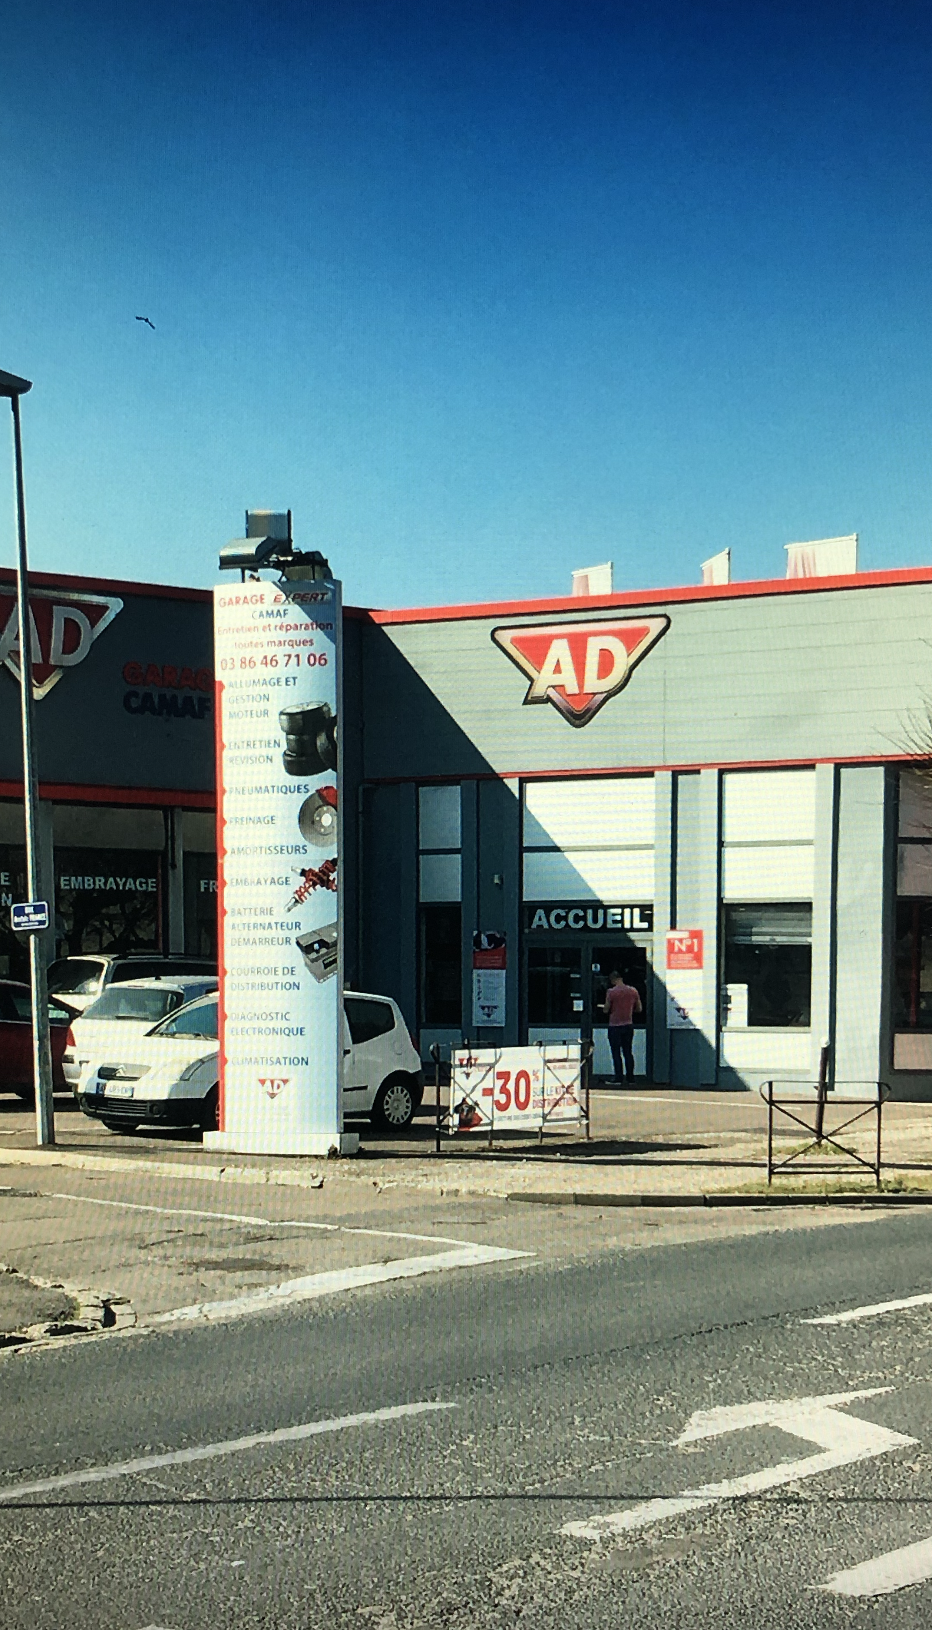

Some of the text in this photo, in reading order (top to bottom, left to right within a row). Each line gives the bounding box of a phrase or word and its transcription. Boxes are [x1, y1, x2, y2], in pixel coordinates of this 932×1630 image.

[219, 592, 328, 607] GARAGE EXPERT
[251, 608, 289, 620] CAMAF
[217, 621, 333, 636] Entretien et réparation
[235, 638, 315, 650] toutes marques
[220, 652, 328, 671] 03 86 46 71 06
[531, 635, 628, 699] AD
[123, 661, 213, 692] GARAG
[228, 676, 298, 689] ALLUMAGE ET
[228, 694, 270, 705] GESTION
[228, 709, 270, 720] MOTEUR
[228, 739, 281, 751] ENTRETIEN
[228, 755, 274, 766] REVISION
[229, 784, 310, 796] PNEUMATIQUES
[229, 815, 276, 826] FREINAGE
[230, 844, 308, 856] AMORTISSEURS
[59, 876, 158, 892] EMBRAYAGE
[231, 877, 290, 887] EMBRAYAGE
[231, 907, 274, 917] BATTERIE
[530, 907, 649, 929] ACCUEIL
[231, 922, 301, 932] ALTERNATEUR
[231, 966, 297, 977] COURROIE DE
[231, 981, 301, 992] DISTRIBUTION
[231, 1012, 291, 1022] DIAGNOSTIC
[232, 1056, 309, 1067] CLIMATISATION
